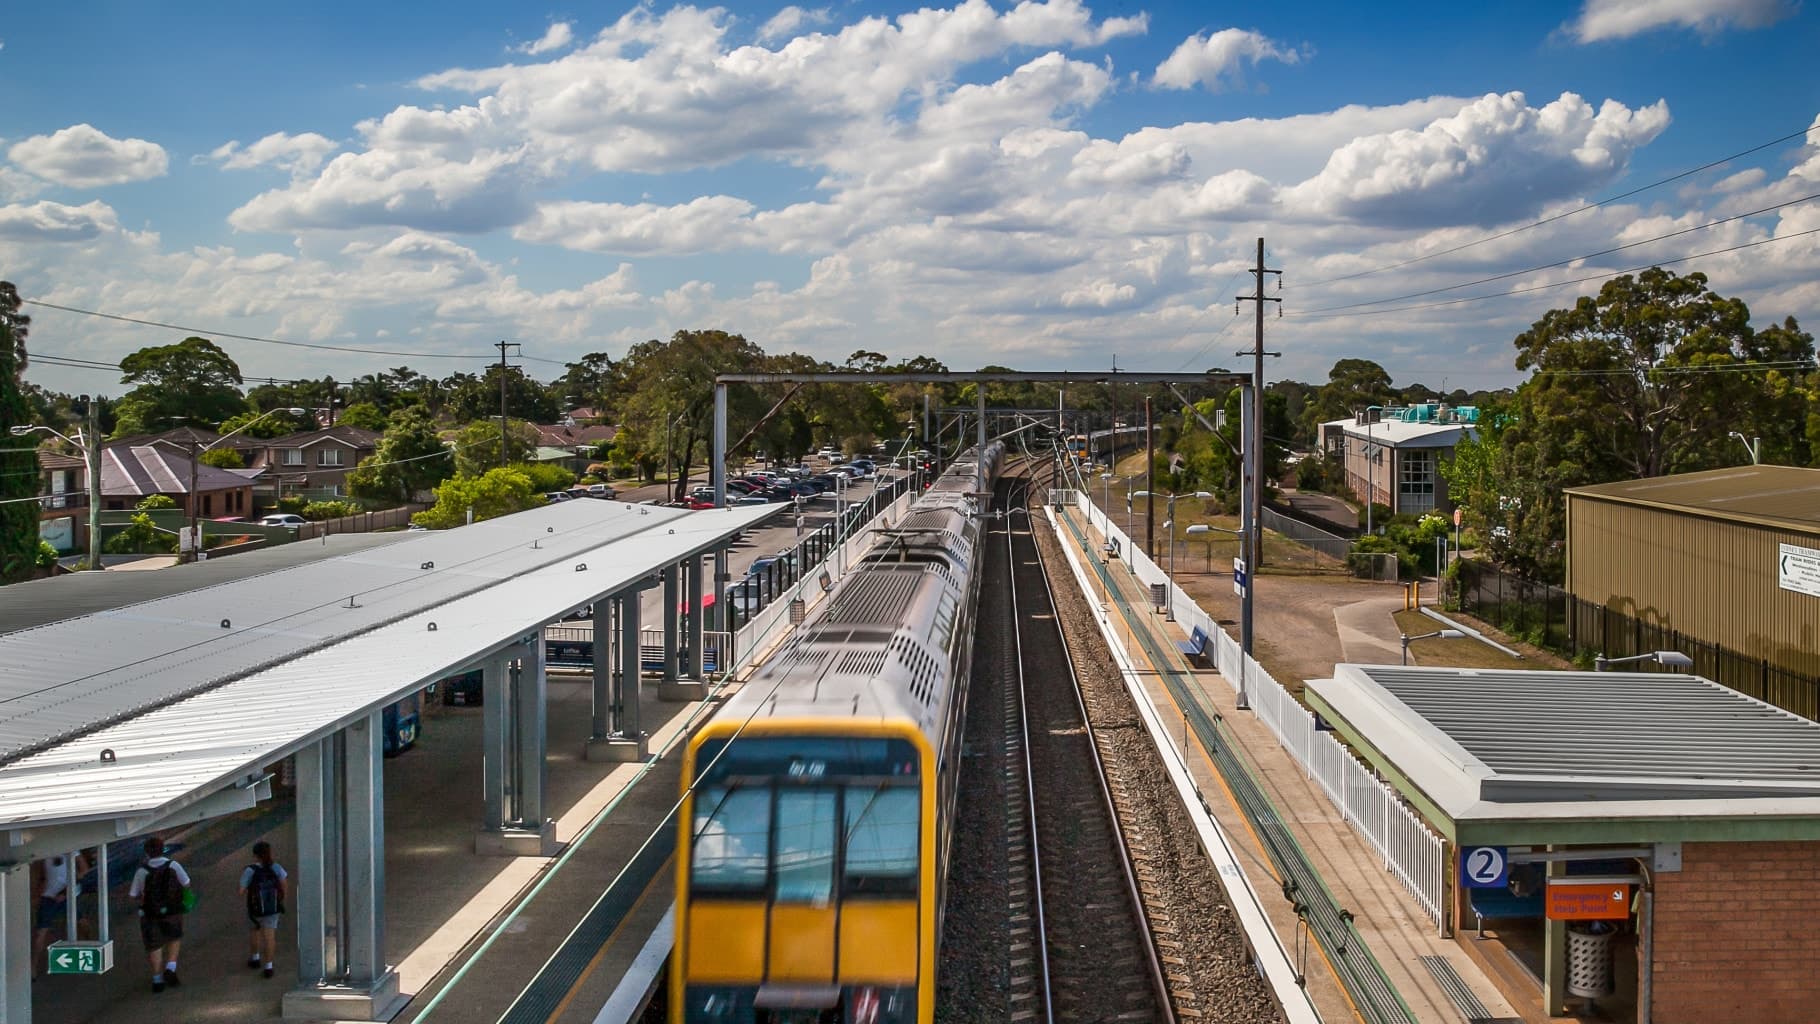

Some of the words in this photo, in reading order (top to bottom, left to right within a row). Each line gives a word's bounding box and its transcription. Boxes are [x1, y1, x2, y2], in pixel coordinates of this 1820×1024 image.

[1476, 851, 1494, 878] 2
[1552, 892, 1608, 903] Emergency
[1554, 904, 1577, 914] Help
[1580, 904, 1608, 913] Point
